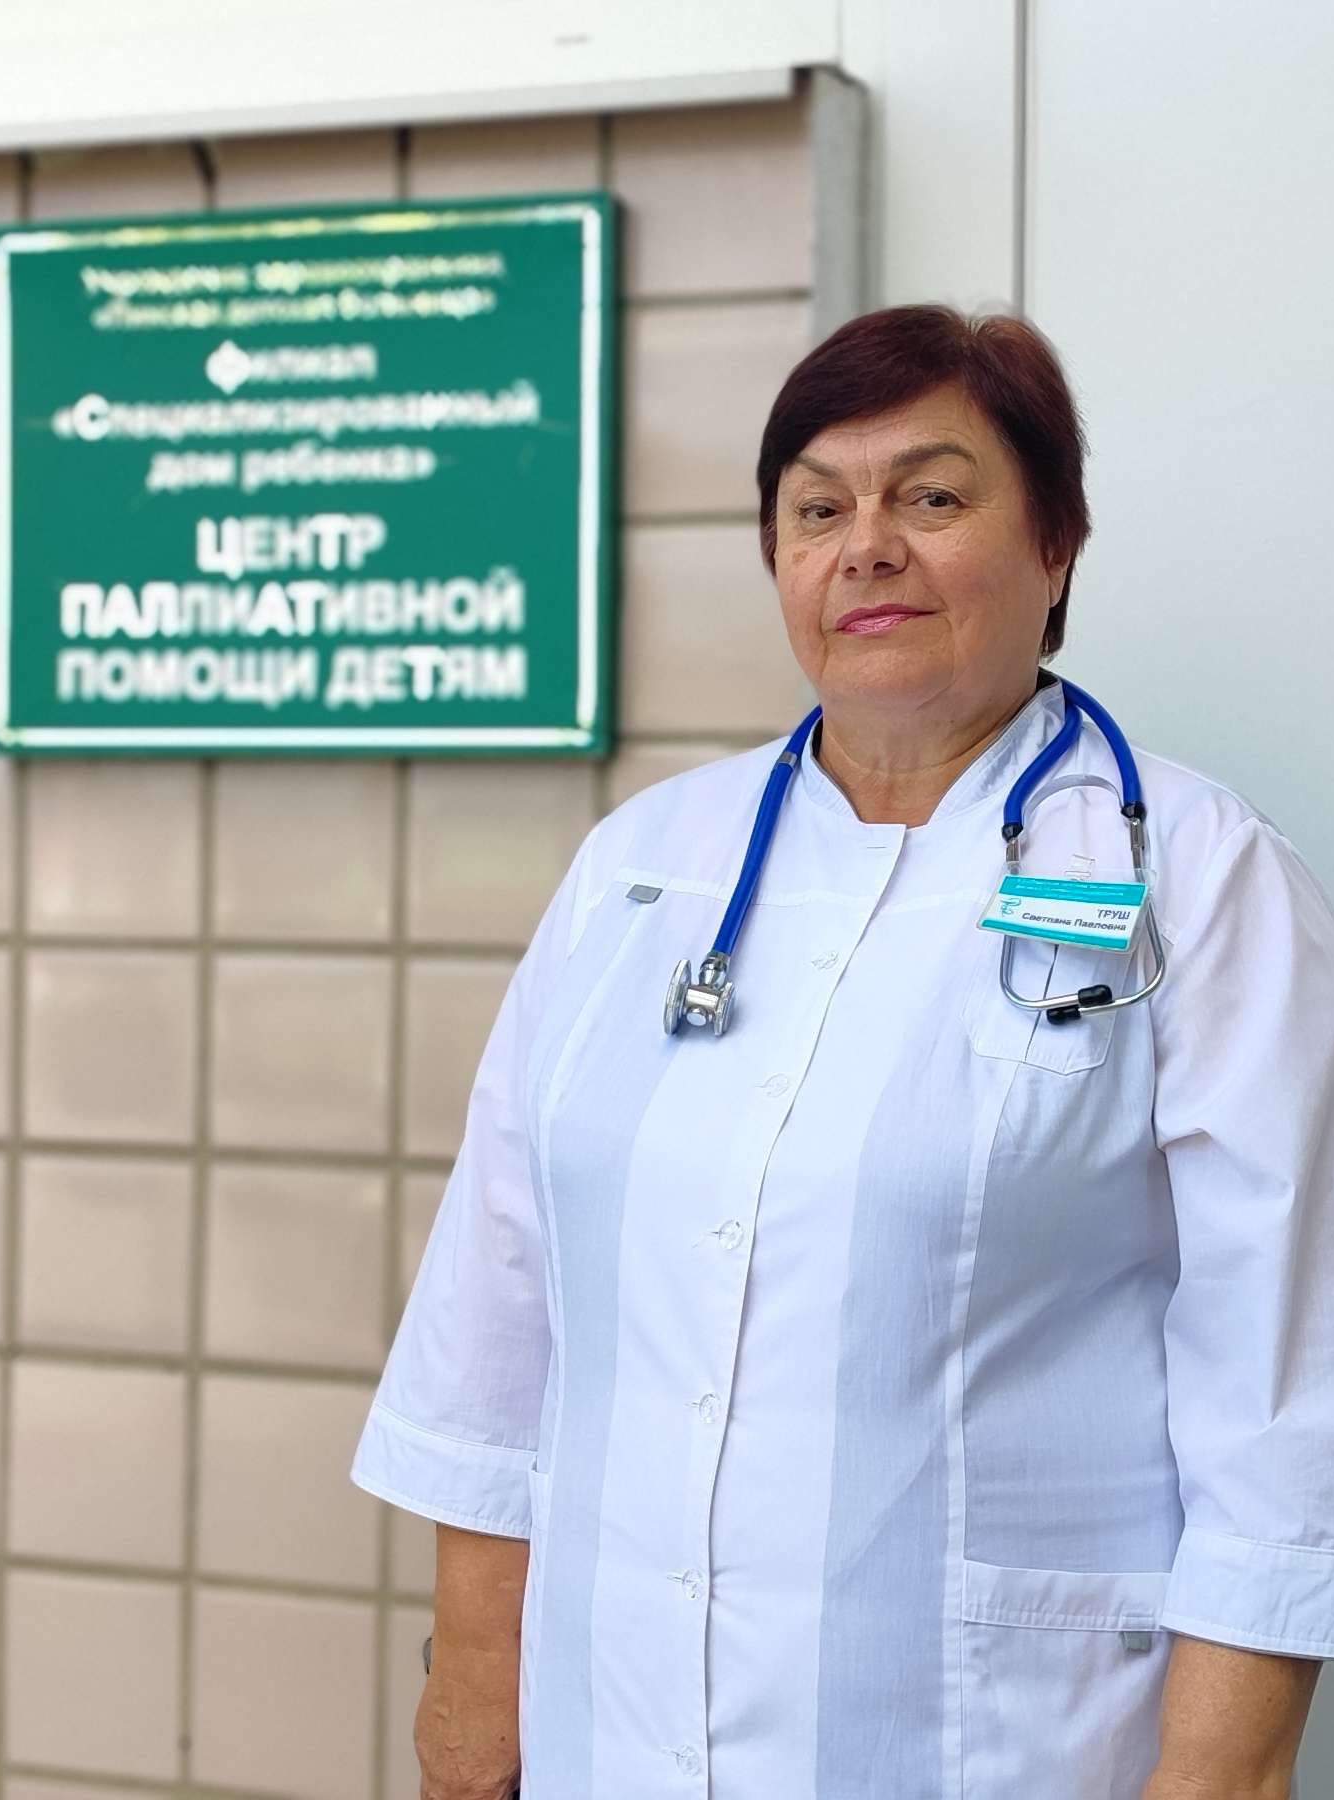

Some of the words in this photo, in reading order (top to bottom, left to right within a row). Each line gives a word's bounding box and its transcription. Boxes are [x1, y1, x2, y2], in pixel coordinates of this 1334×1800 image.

[197, 513, 385, 580] ЦЕНТР
[60, 567, 524, 638] ПАЛЛИАТИВНОЙ
[58, 647, 317, 708] ПОМОЩИ
[325, 645, 527, 708] ДЕТЯМ
